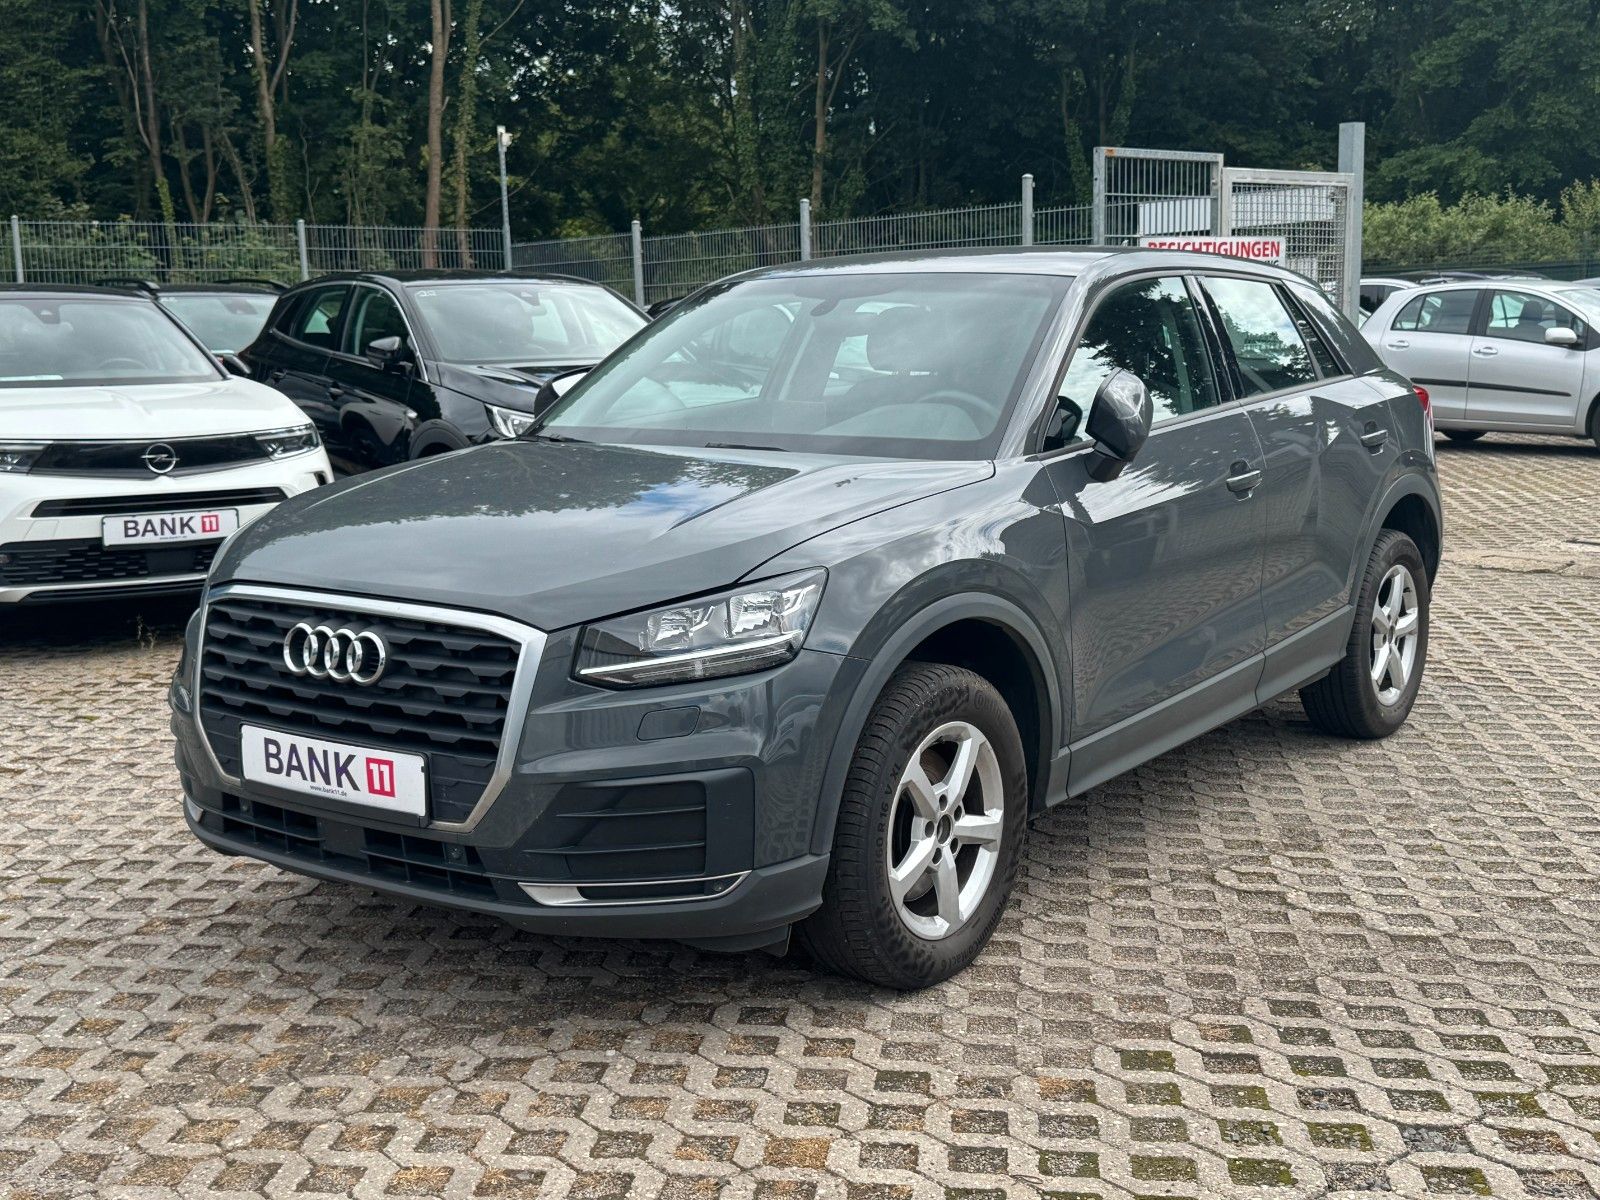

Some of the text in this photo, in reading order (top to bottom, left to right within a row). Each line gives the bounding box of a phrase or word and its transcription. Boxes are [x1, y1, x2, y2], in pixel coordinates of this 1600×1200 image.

[123, 516, 218, 538] BANK 11
[264, 737, 393, 795] BANK 11
[309, 784, 348, 798] www.bank11.de
